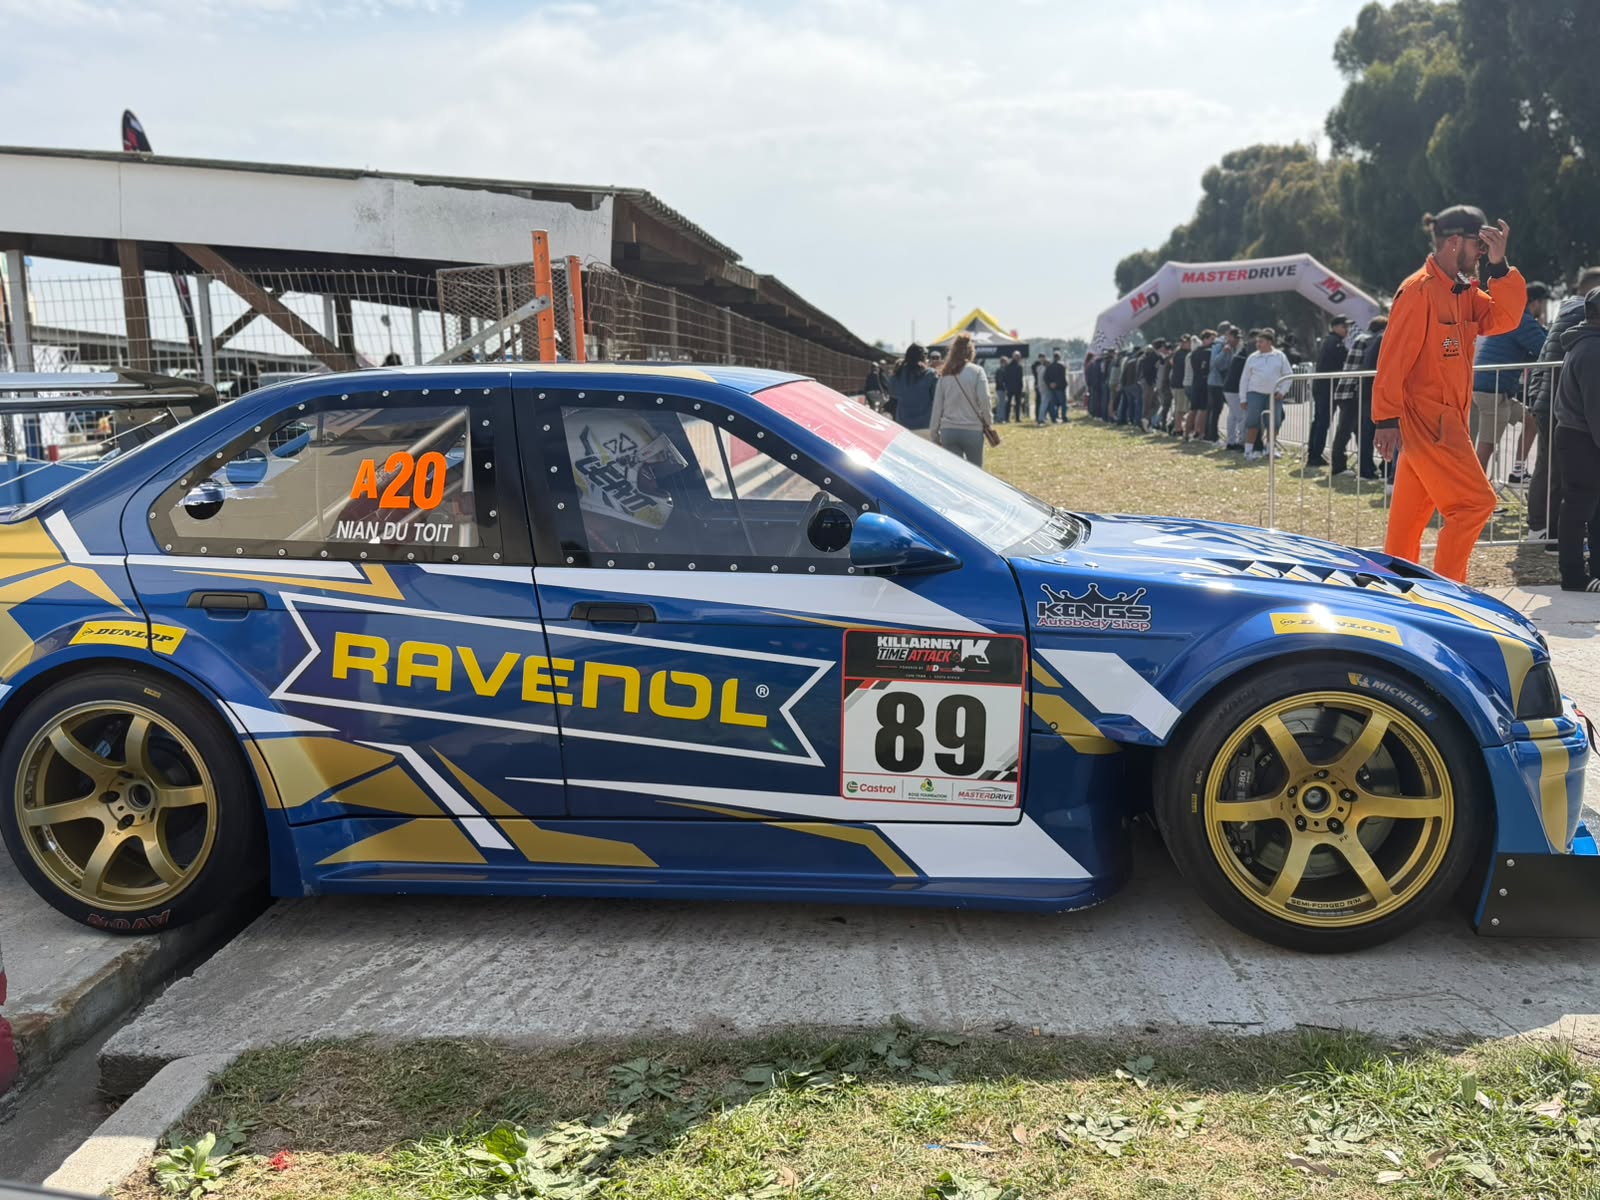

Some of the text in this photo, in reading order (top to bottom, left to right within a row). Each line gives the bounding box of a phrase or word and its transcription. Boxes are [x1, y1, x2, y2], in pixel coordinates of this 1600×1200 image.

[1181, 264, 1297, 284] MASTERDRIVE
[350, 451, 447, 510] A20
[336, 521, 453, 542] NIAN DU TOIT
[1037, 601, 1151, 621] KINGS
[1037, 617, 1151, 631] Autobody Shop
[95, 628, 175, 642] DUNLOP
[877, 636, 960, 650] KILLARNEY
[877, 647, 953, 663] TIME ATTACK
[1371, 680, 1433, 717] MICHELIN
[875, 691, 987, 777] 89
[859, 783, 897, 794] Castrol
[958, 791, 1015, 801] MASTERDRIVE
